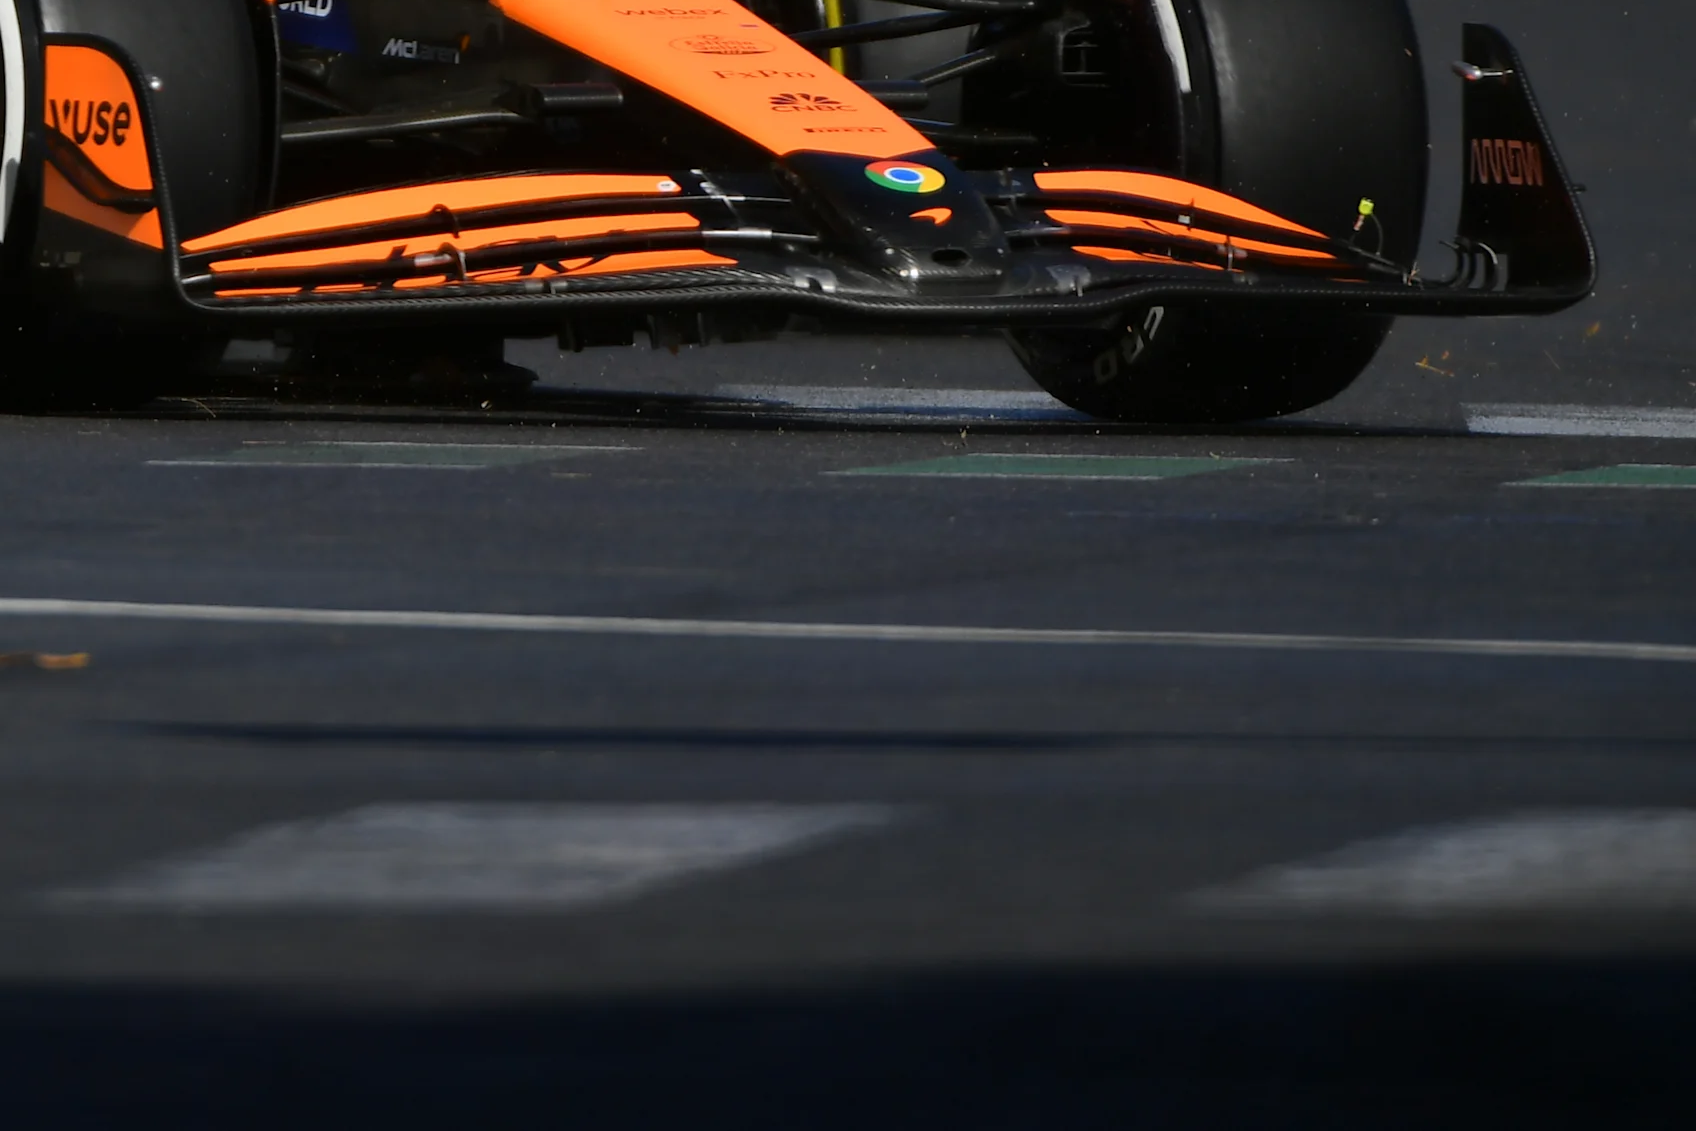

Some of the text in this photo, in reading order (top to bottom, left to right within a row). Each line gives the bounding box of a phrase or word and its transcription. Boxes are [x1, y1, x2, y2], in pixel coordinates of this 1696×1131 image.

[615, 6, 730, 16] webex
[383, 37, 460, 64] McLaren
[711, 68, 817, 81] FxPro
[770, 104, 859, 113] CNBC
